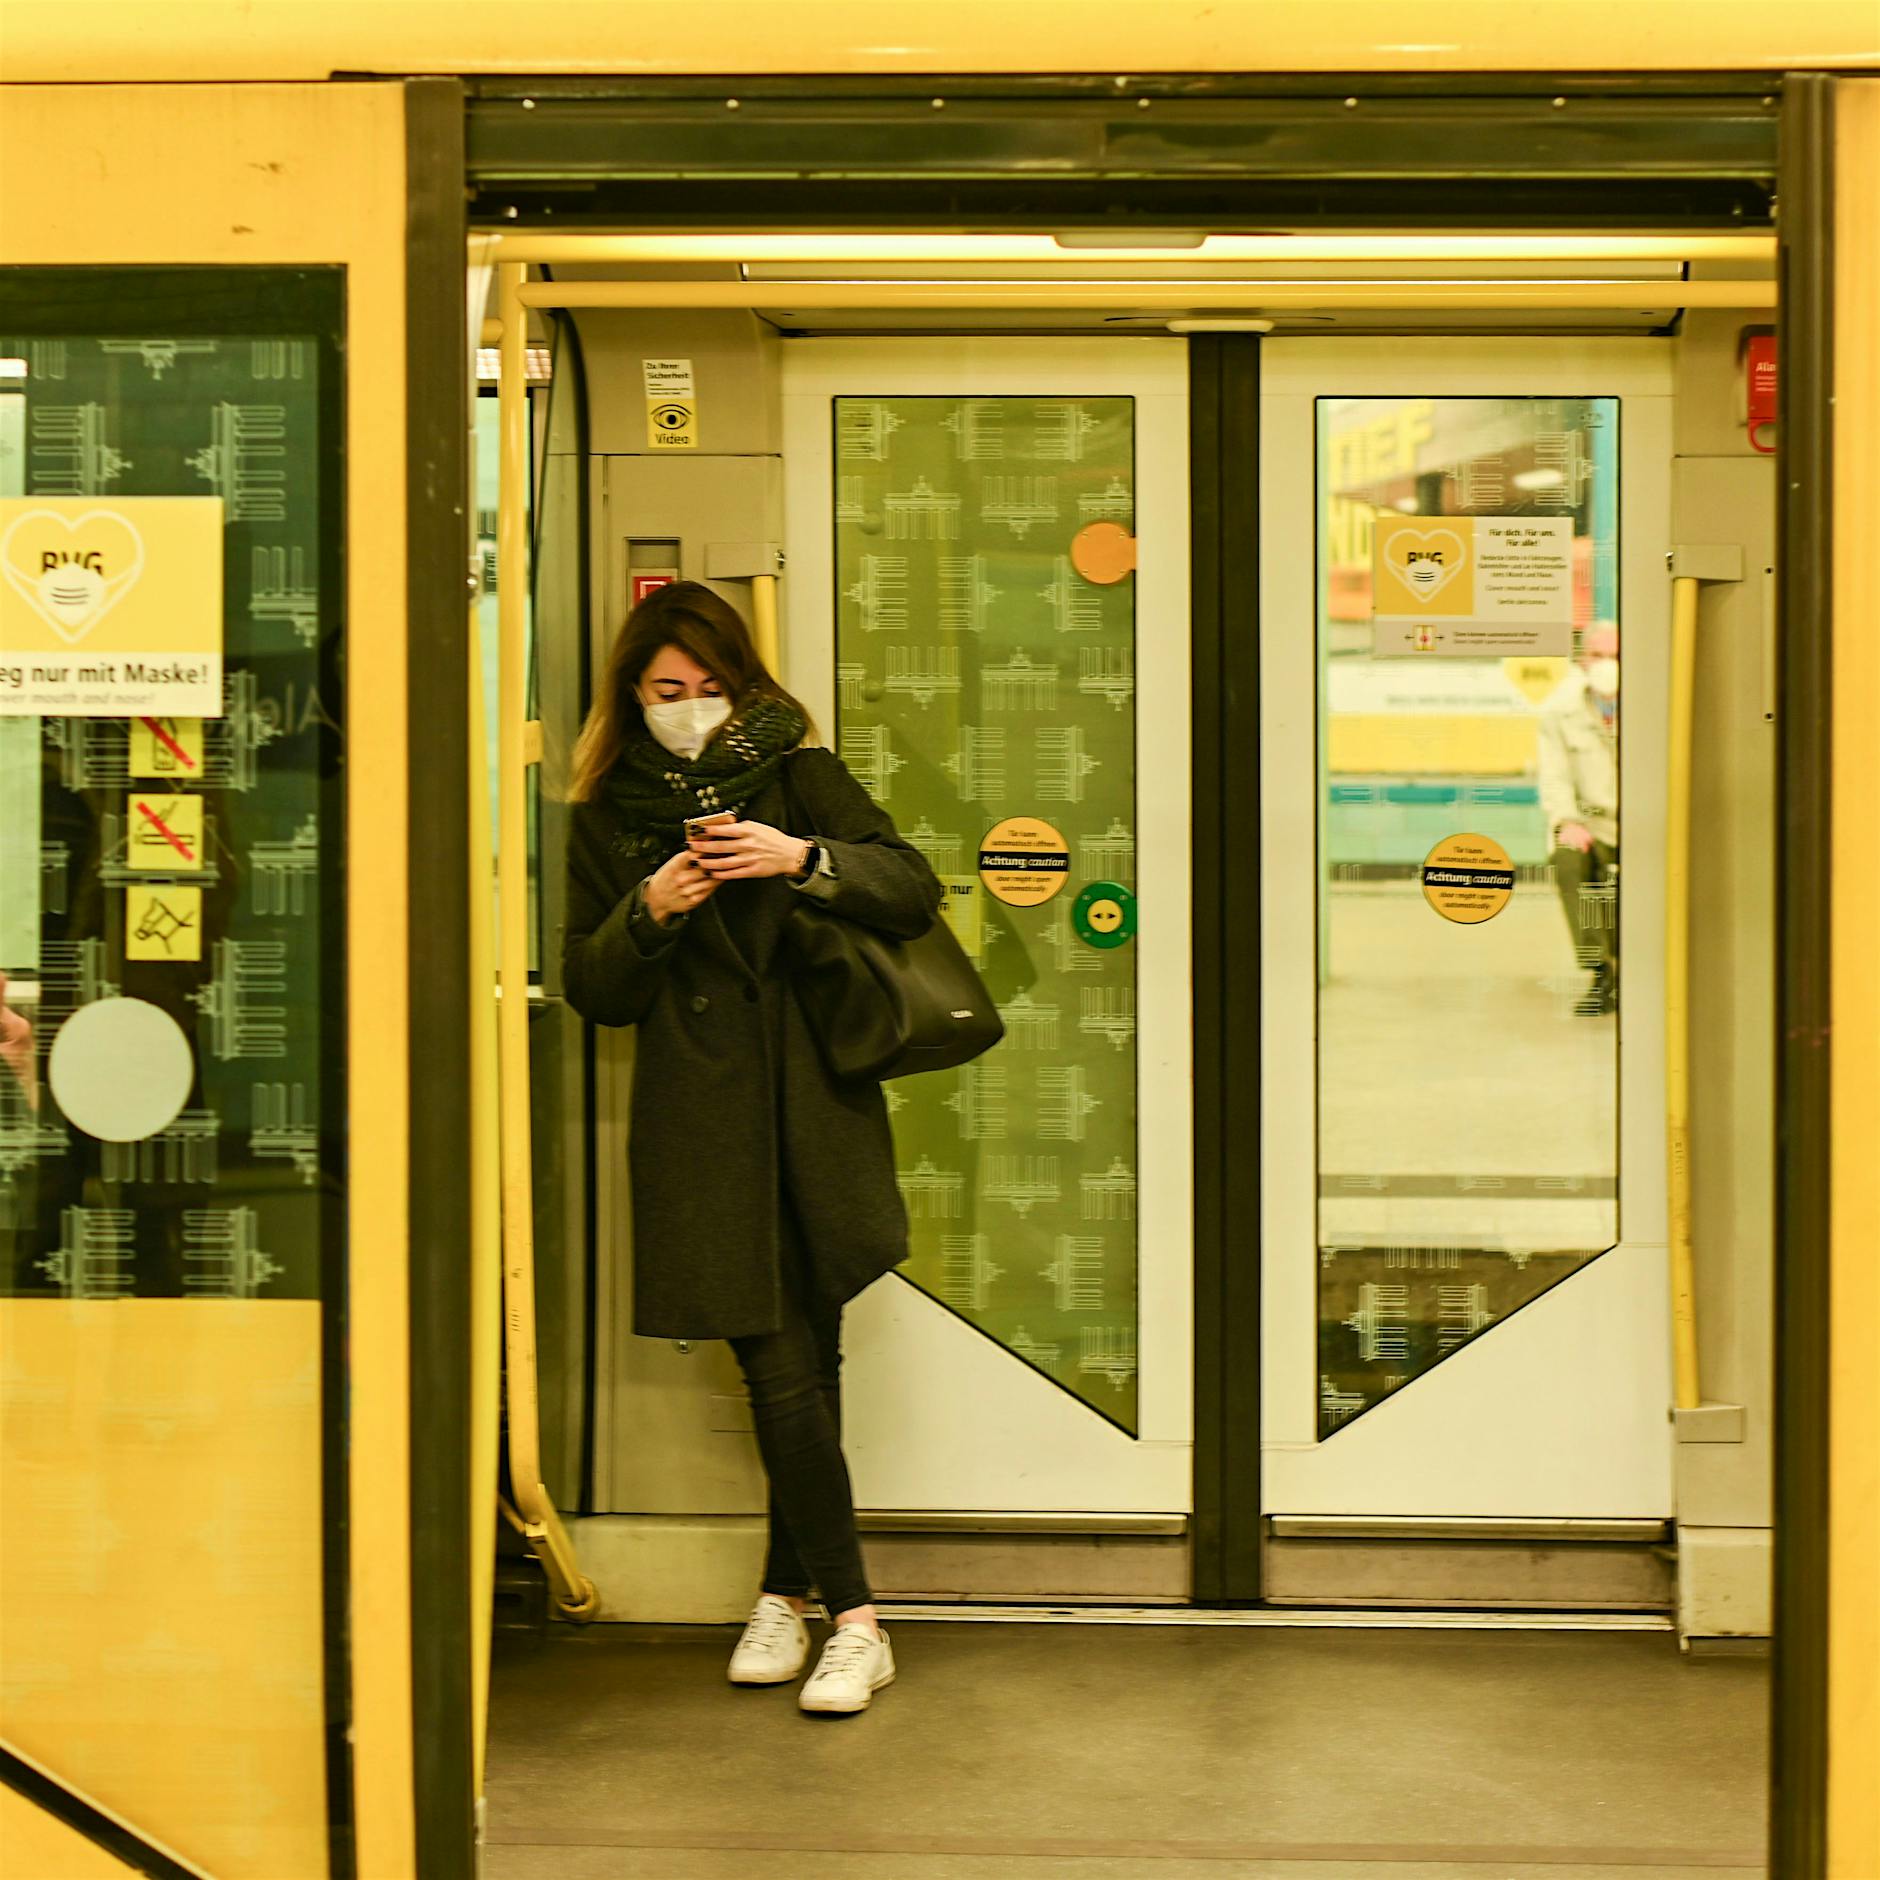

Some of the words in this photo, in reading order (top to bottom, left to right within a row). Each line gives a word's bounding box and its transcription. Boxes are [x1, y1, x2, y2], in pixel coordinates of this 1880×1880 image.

[655, 433, 689, 445] Video
[1489, 528, 1501, 537] Für
[1504, 528, 1522, 537] dich.
[1524, 528, 1537, 537] Für
[1506, 539, 1518, 547] Für
[31, 667, 69, 683] nur
[78, 662, 115, 683] mit
[124, 663, 209, 684] Maske!
[31, 692, 77, 704] mouth
[82, 692, 110, 704] and
[114, 692, 155, 704] nose!
[982, 855, 1027, 868] Achtung
[1028, 857, 1067, 867] caution
[1426, 871, 1472, 885] Achtung
[1473, 874, 1512, 885] caution
[950, 885, 974, 895] nur
